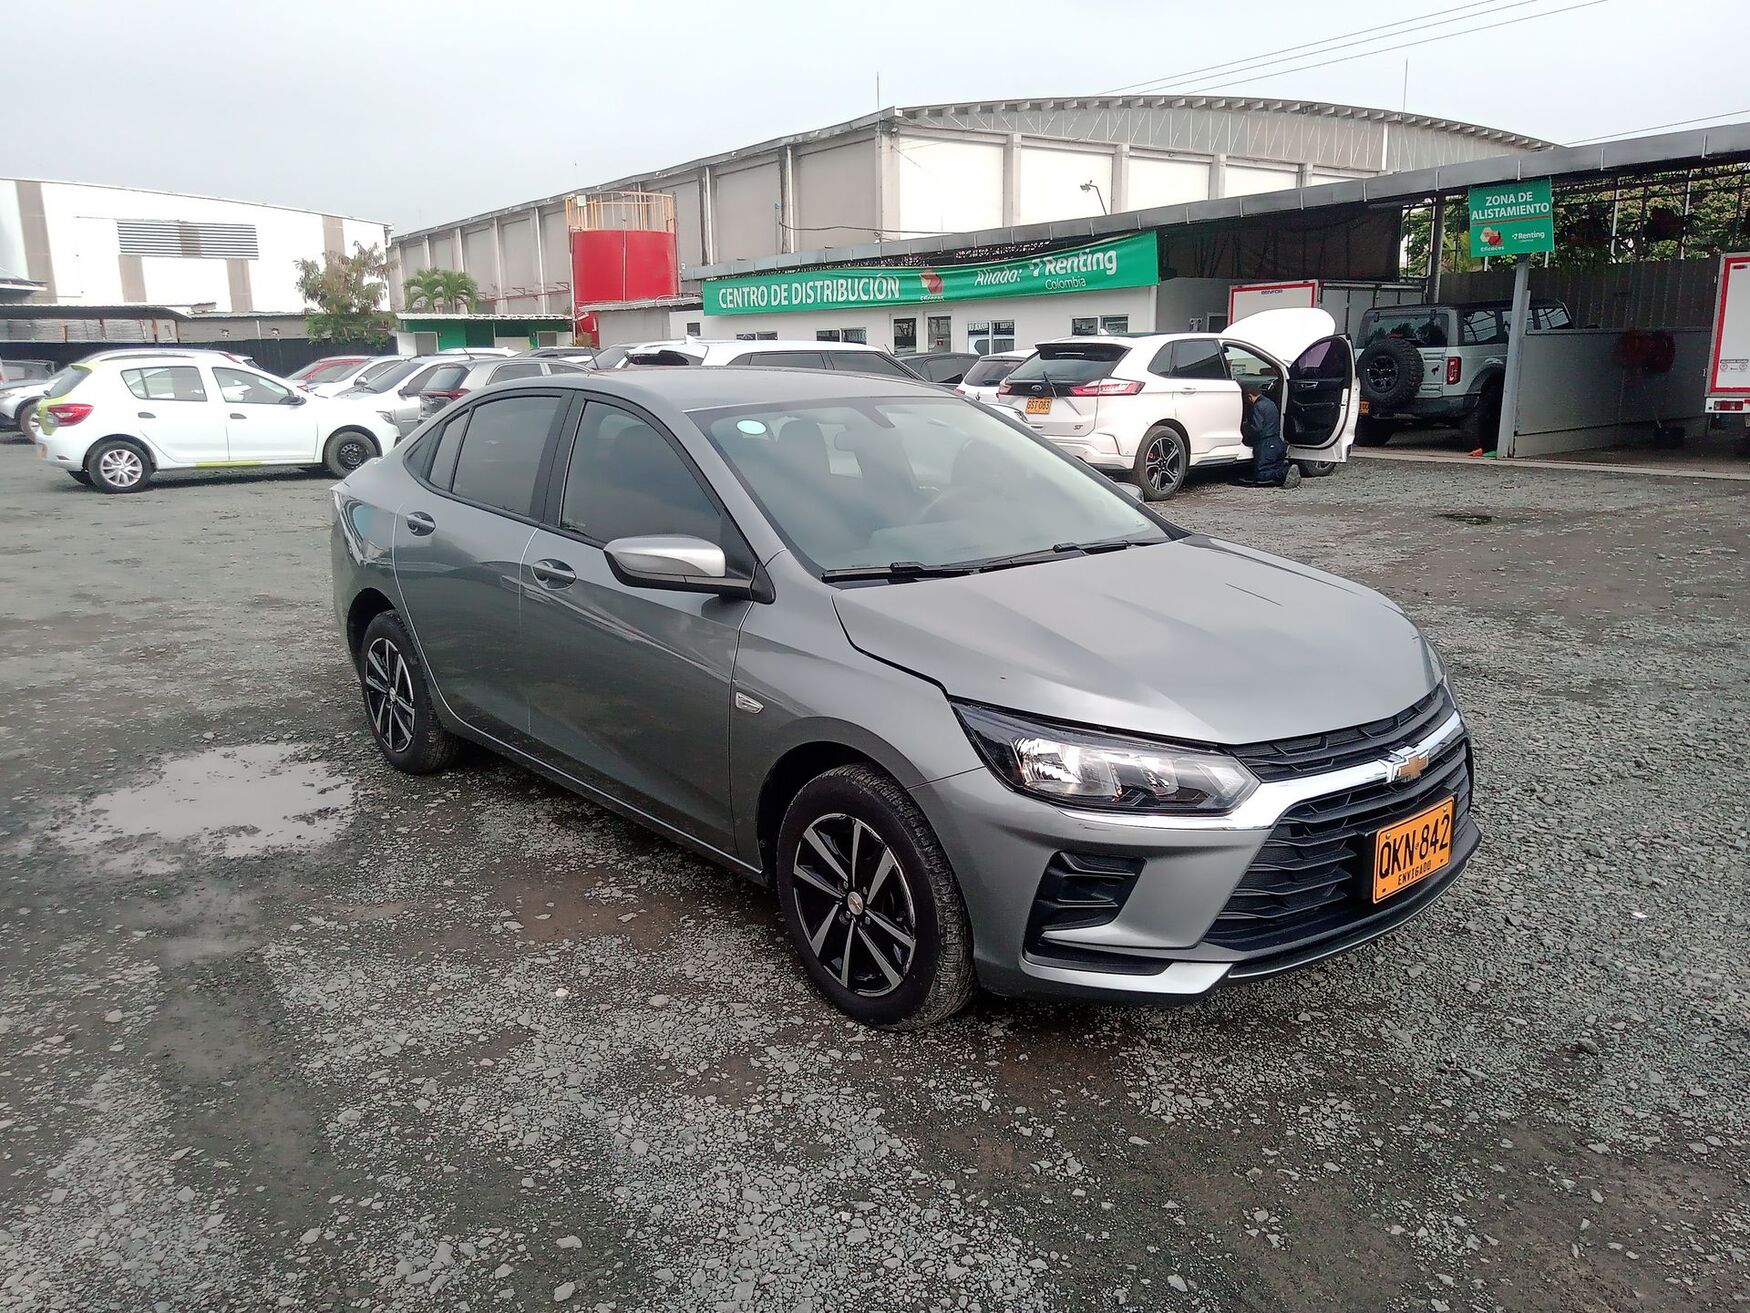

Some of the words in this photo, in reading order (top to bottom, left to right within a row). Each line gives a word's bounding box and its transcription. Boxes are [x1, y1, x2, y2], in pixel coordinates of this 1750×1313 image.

[1485, 194, 1516, 206] ZONA
[1518, 191, 1533, 202] DE
[1471, 202, 1550, 220] ALISTAMIENTO
[1518, 230, 1545, 240] Renting
[1042, 248, 1118, 276] Renting
[974, 266, 1022, 287] Aliado:
[1045, 276, 1087, 290] Colombia
[718, 285, 768, 309] CENTRO
[770, 283, 789, 306] DE
[791, 273, 900, 305] DISTRIBUCIÓN
[1398, 860, 1431, 885] ENVIGADO
